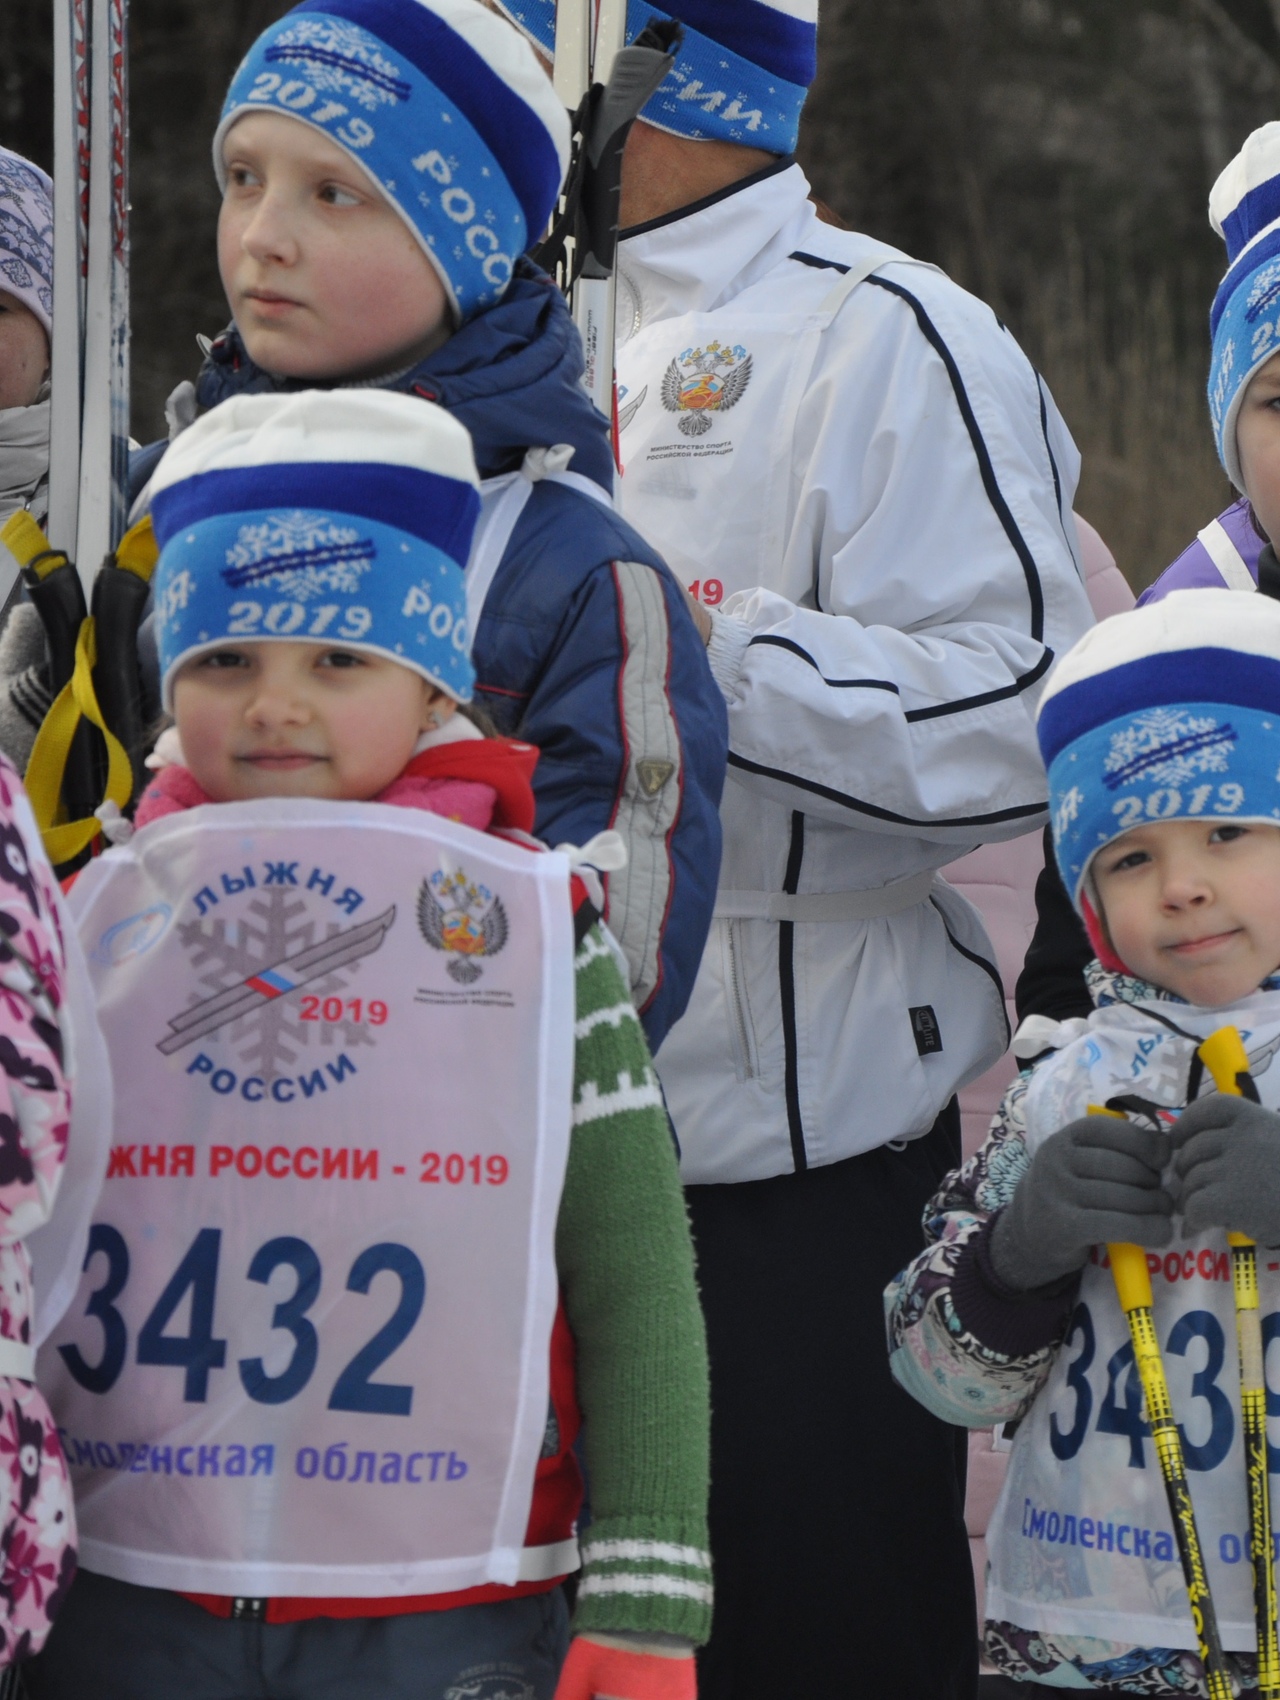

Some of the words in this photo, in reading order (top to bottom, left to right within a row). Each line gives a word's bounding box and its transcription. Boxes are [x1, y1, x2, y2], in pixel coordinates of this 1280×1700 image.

[248, 72, 375, 148] 2019
[412, 150, 514, 290] РОСС
[650, 444, 705, 453] МИНИСТЕРСТВО
[706, 440, 732, 449] СПОРТА
[227, 601, 373, 639] 2019
[1112, 783, 1245, 828] 2019
[193, 861, 365, 917] ЛЫЖНЯ
[298, 995, 389, 1026] 2019
[186, 1053, 358, 1103] РОССИИ
[209, 1145, 379, 1181] РОССИИ
[420, 1152, 510, 1186] 2019
[1147, 1248, 1242, 1285] РОССИ
[57, 1223, 427, 1416] 3432
[295, 1441, 469, 1484] область
[1022, 1498, 1182, 1563] Смоленска
